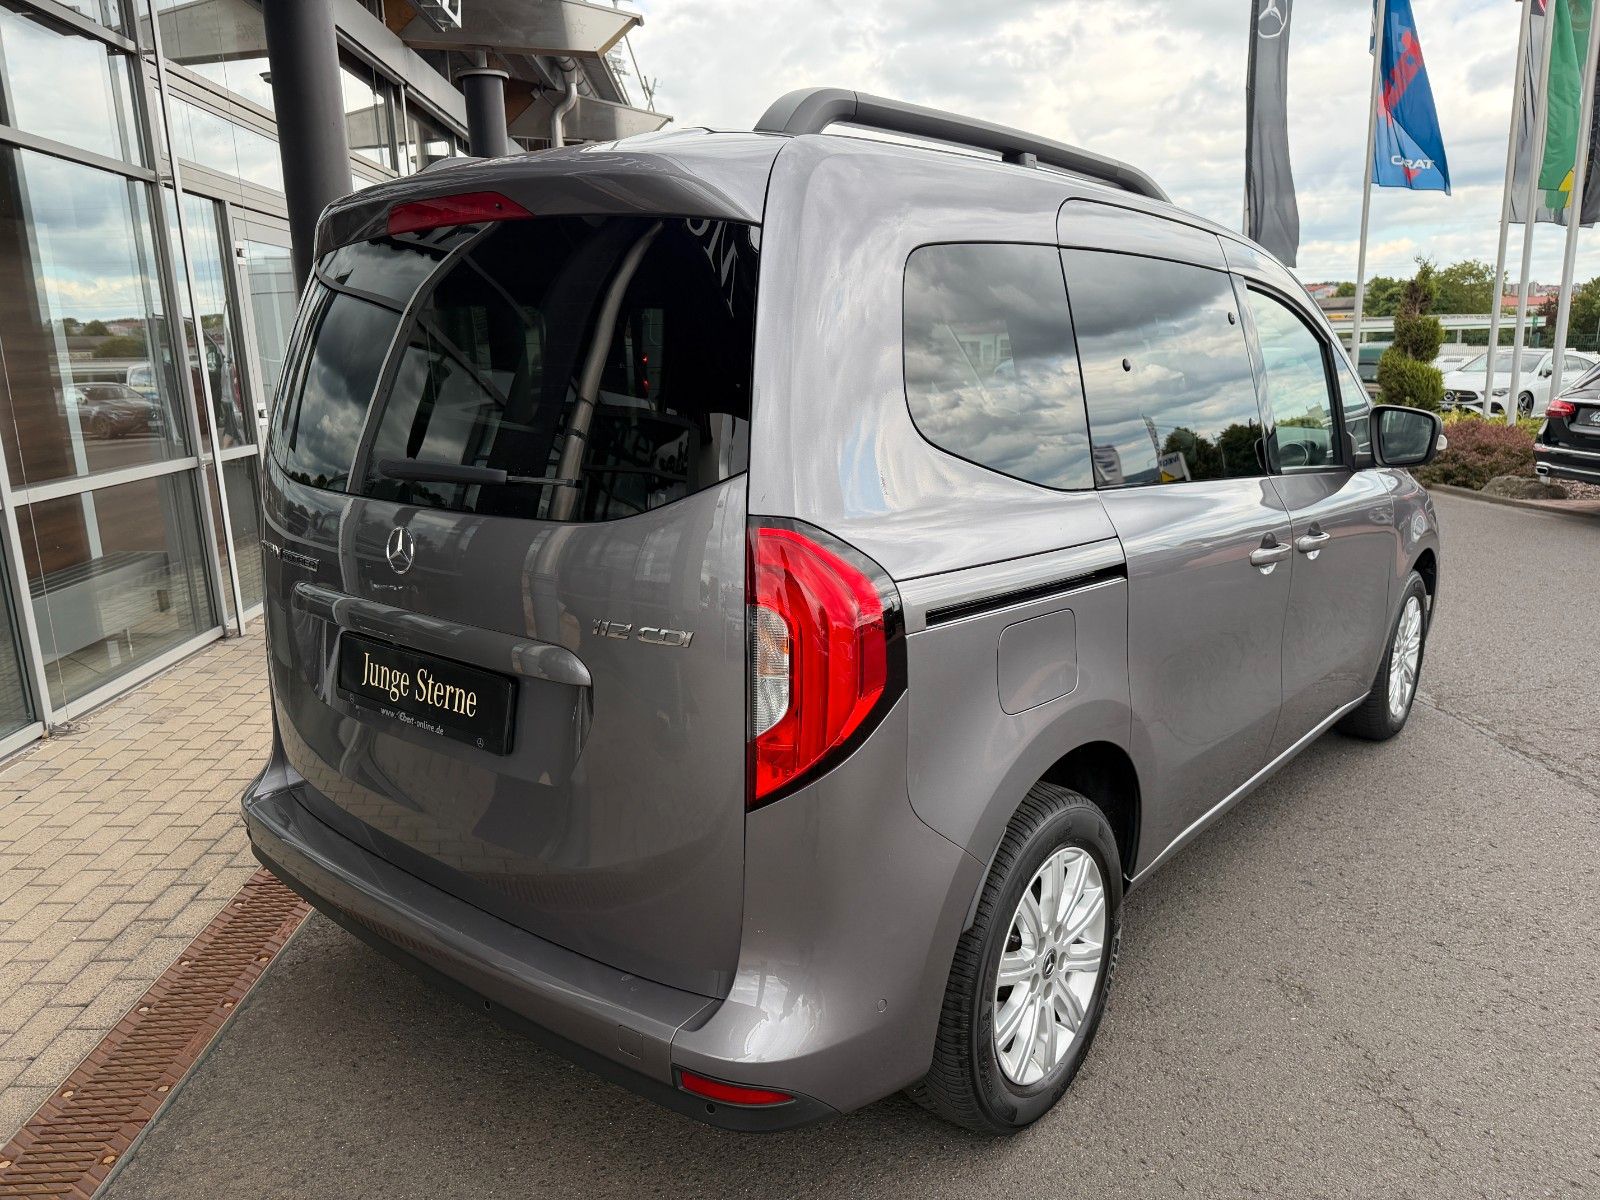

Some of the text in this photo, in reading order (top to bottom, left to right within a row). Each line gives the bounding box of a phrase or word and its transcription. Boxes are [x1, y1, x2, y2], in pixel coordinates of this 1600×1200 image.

[592, 619, 694, 648] 112 CDI
[361, 652, 477, 717] Junge Sterne
